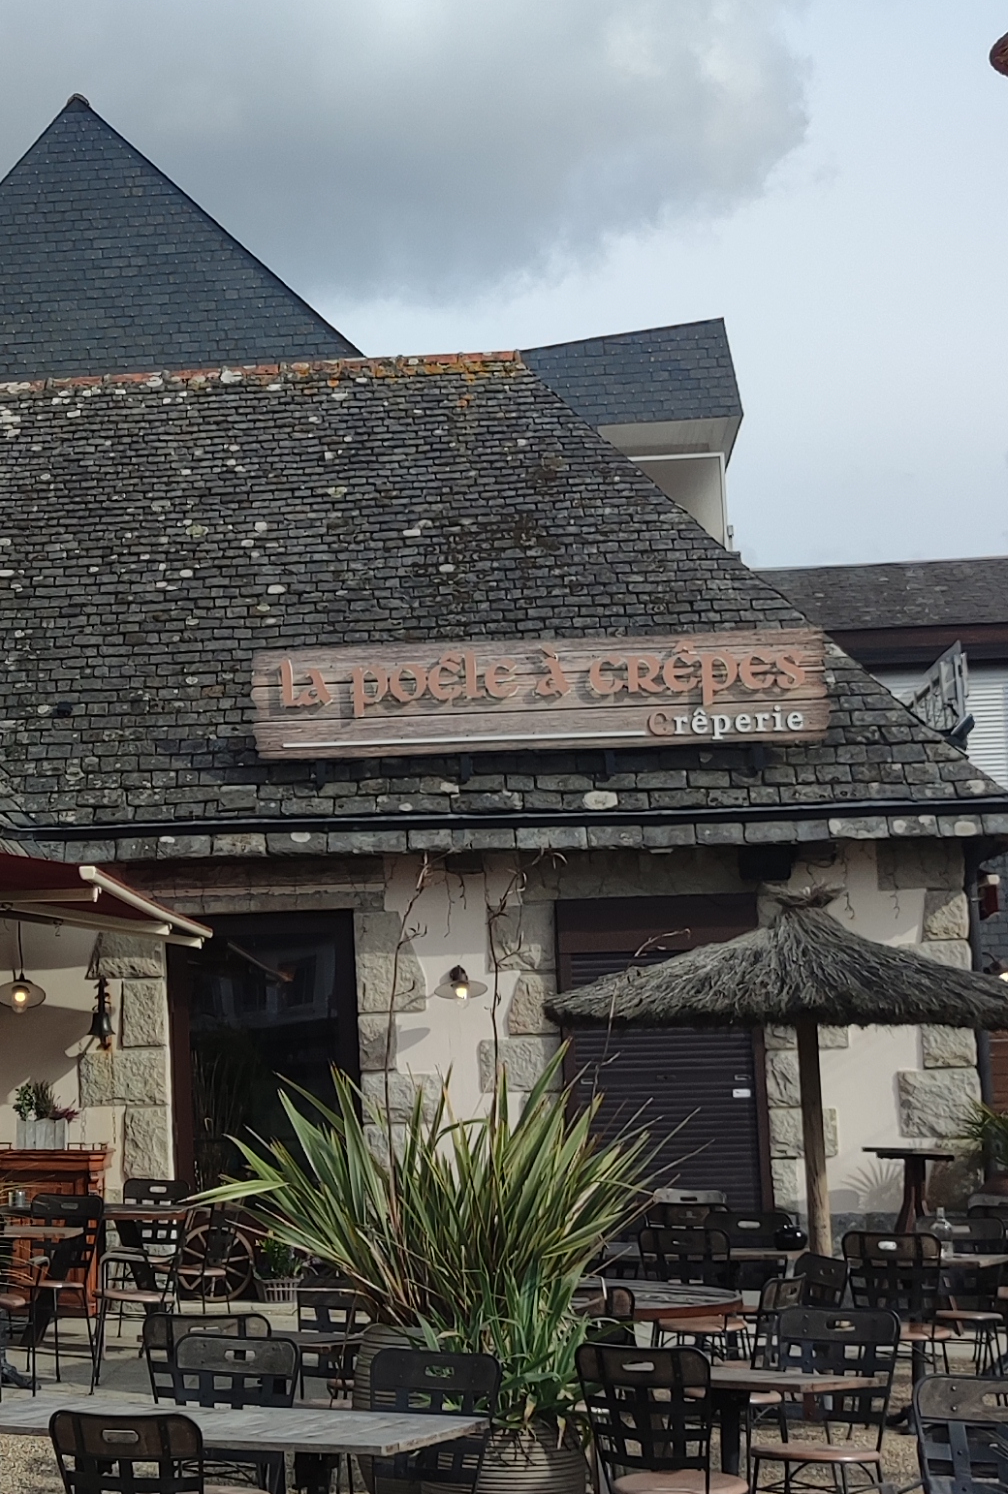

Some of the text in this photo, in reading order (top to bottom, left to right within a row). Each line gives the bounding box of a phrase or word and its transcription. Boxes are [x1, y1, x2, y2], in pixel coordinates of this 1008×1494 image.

[278, 657, 333, 707] la
[348, 649, 520, 718] poêle
[534, 642, 572, 697] à
[648, 705, 805, 740] Crêperie
